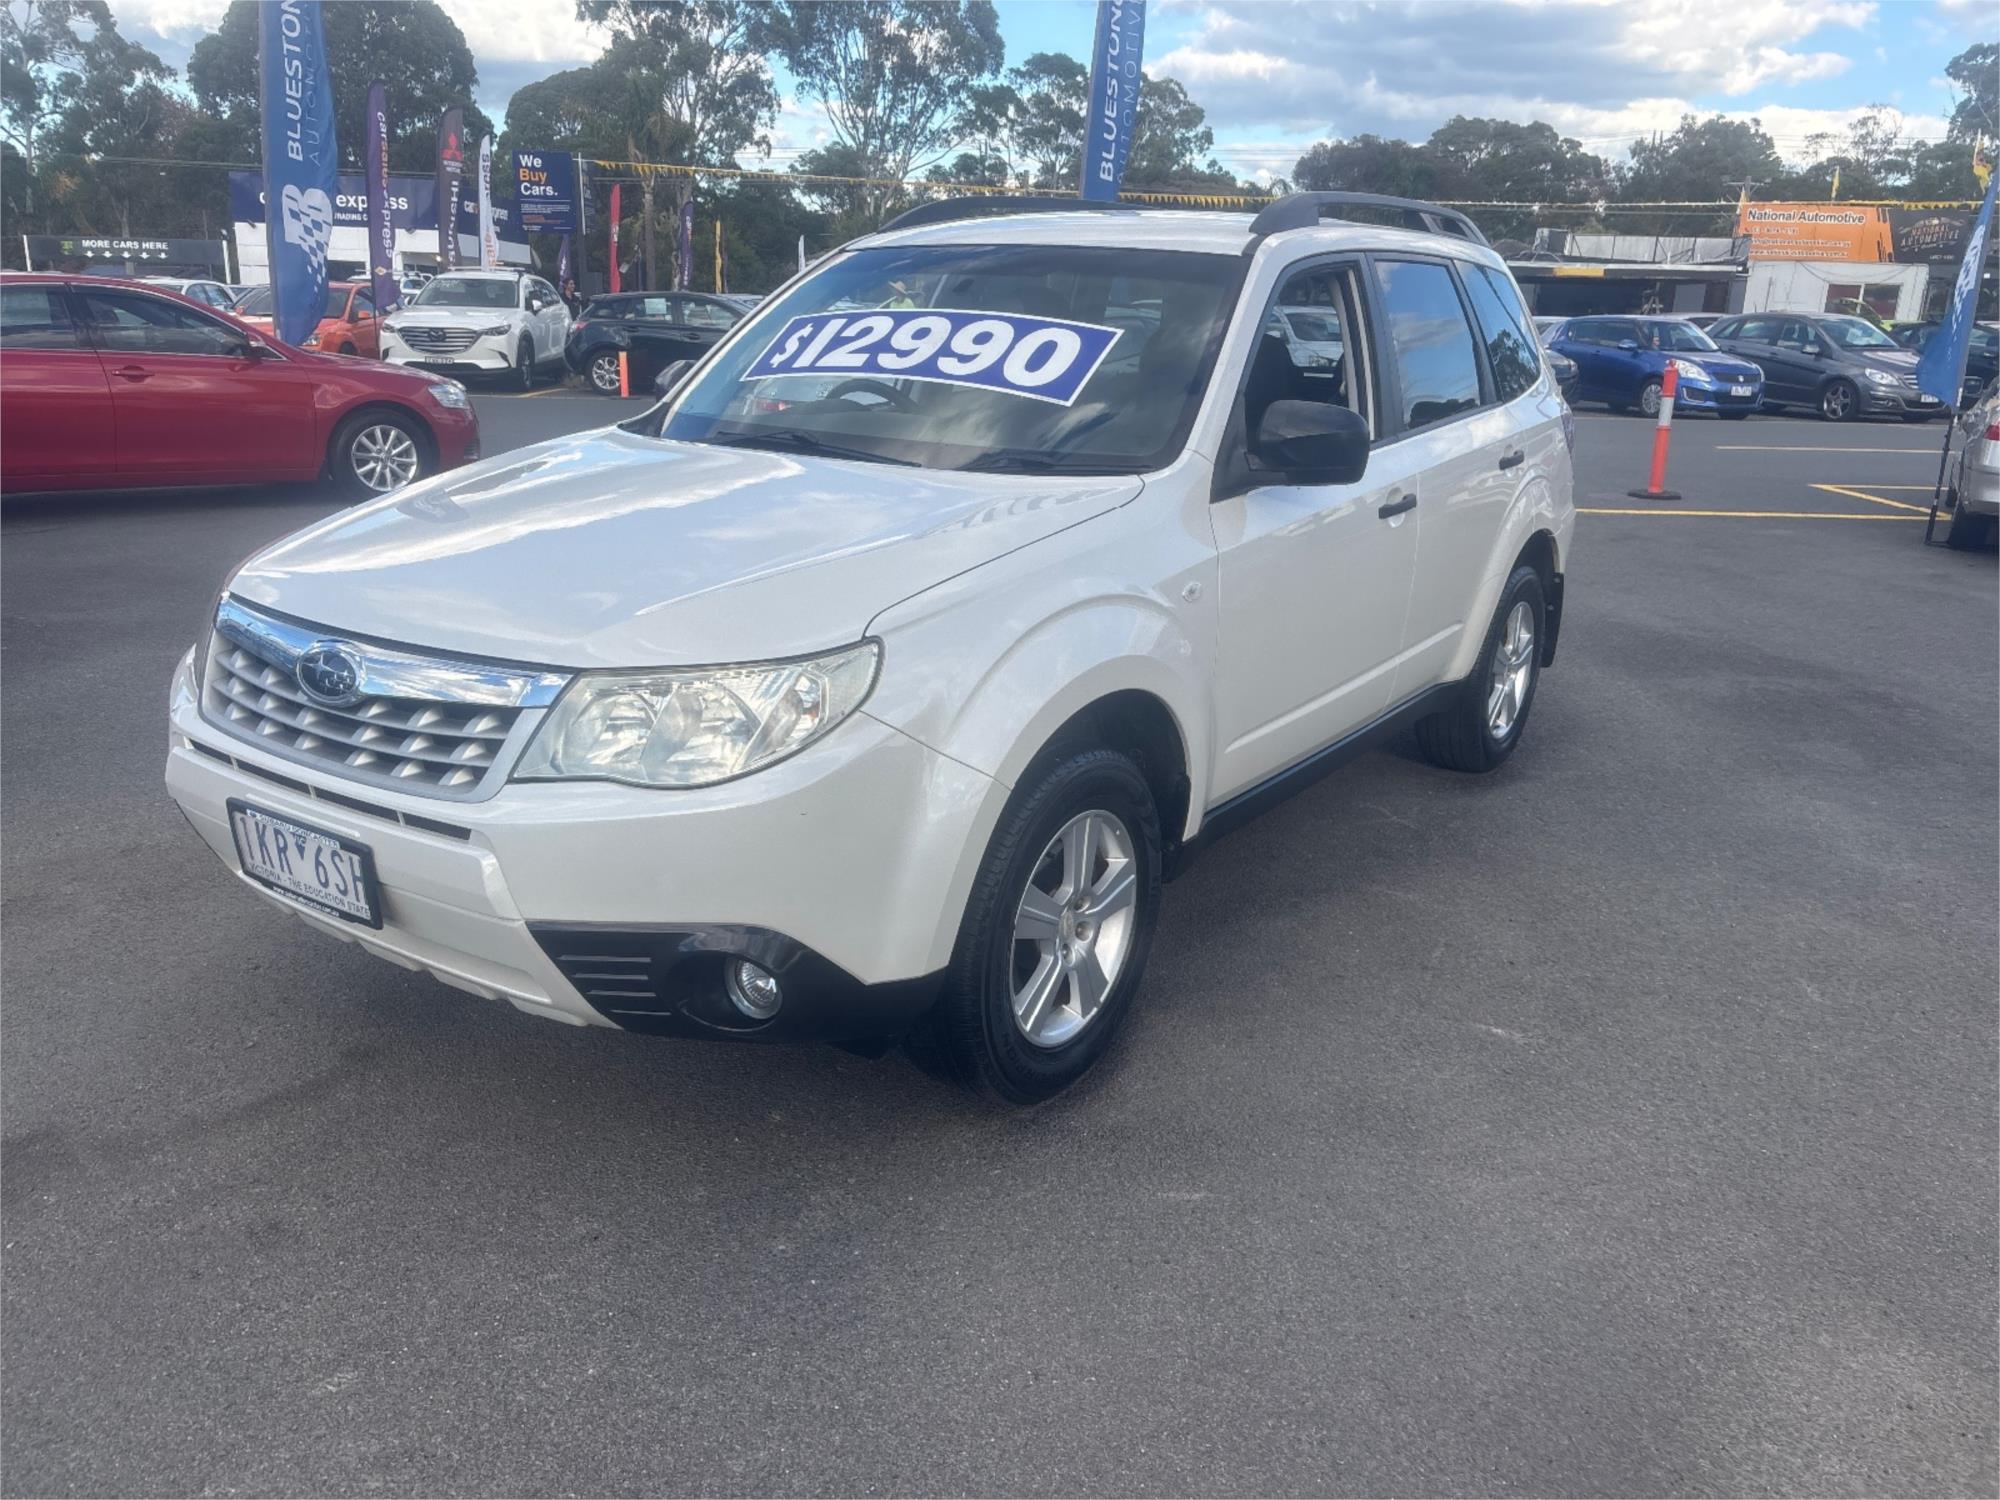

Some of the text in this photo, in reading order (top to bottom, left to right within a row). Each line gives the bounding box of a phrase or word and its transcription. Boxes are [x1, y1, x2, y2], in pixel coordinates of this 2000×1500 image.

[1116, 0, 1146, 185] AUTOMOTIV
[519, 154, 543, 168] We
[519, 168, 548, 184] Buy
[521, 182, 559, 196] Cars.
[1747, 209, 1865, 225] National Automotive
[81, 239, 169, 251] MORE CARS HERE
[769, 315, 1082, 387] $12990
[315, 844, 363, 904] 6SH
